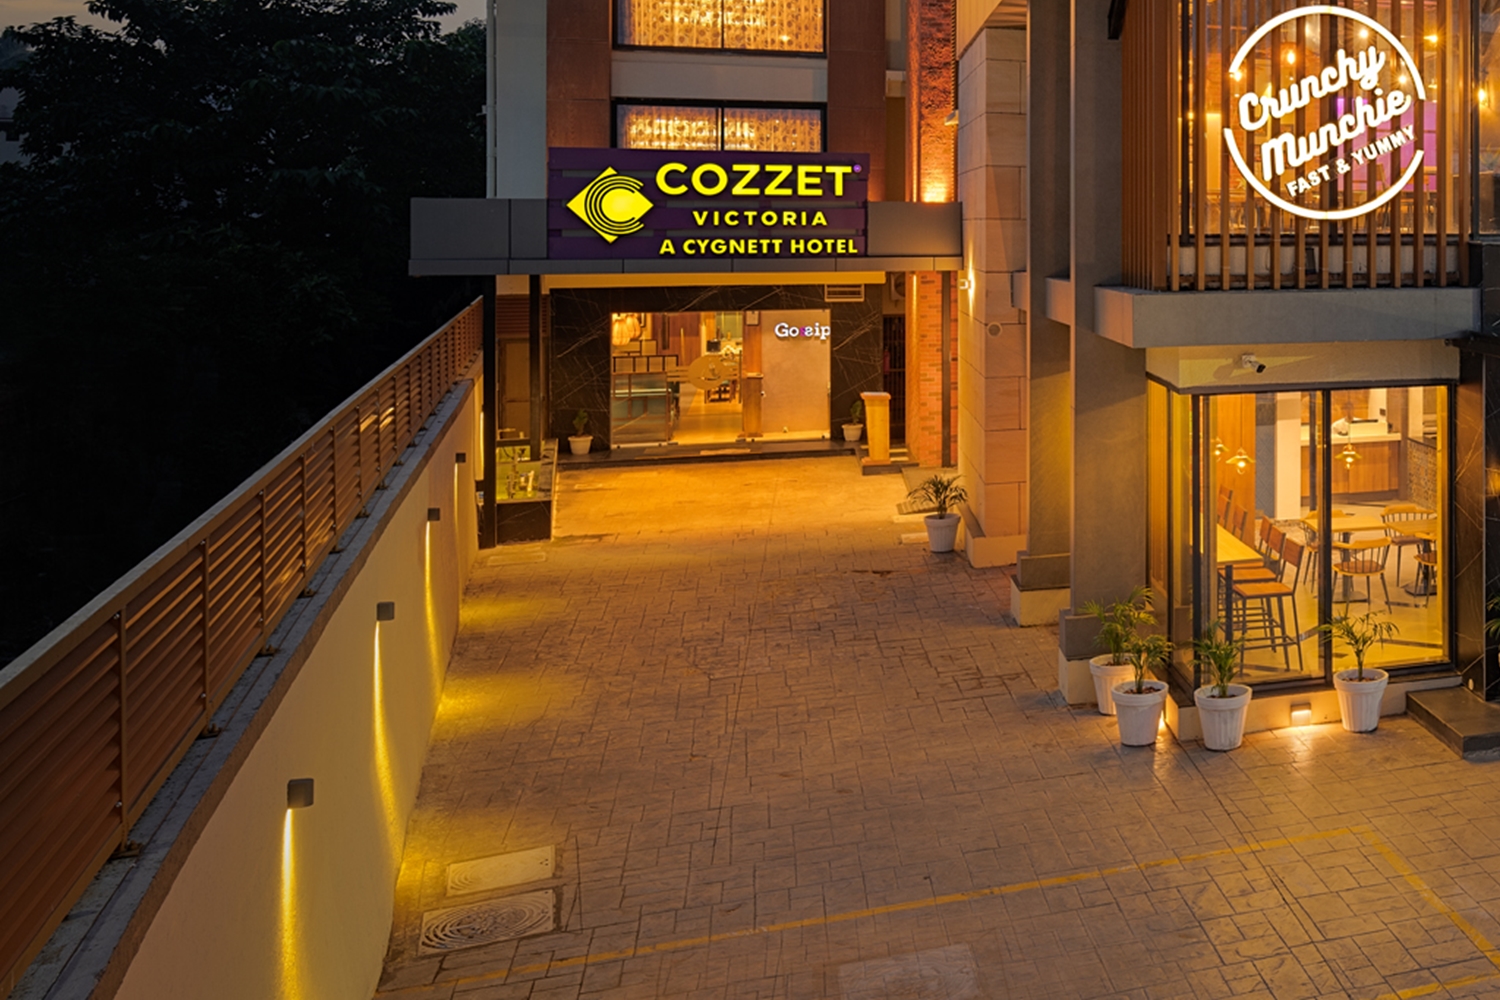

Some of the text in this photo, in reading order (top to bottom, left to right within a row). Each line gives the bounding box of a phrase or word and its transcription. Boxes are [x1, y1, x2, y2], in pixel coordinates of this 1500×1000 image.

[1239, 46, 1386, 131] Crunchy
[1261, 89, 1412, 182] Munchie
[1286, 124, 1415, 197] FAST & YUMMY
[655, 162, 852, 196] COZZET
[693, 211, 827, 226] VICTORIA
[659, 239, 858, 254] A CYGNETT HOTEL
